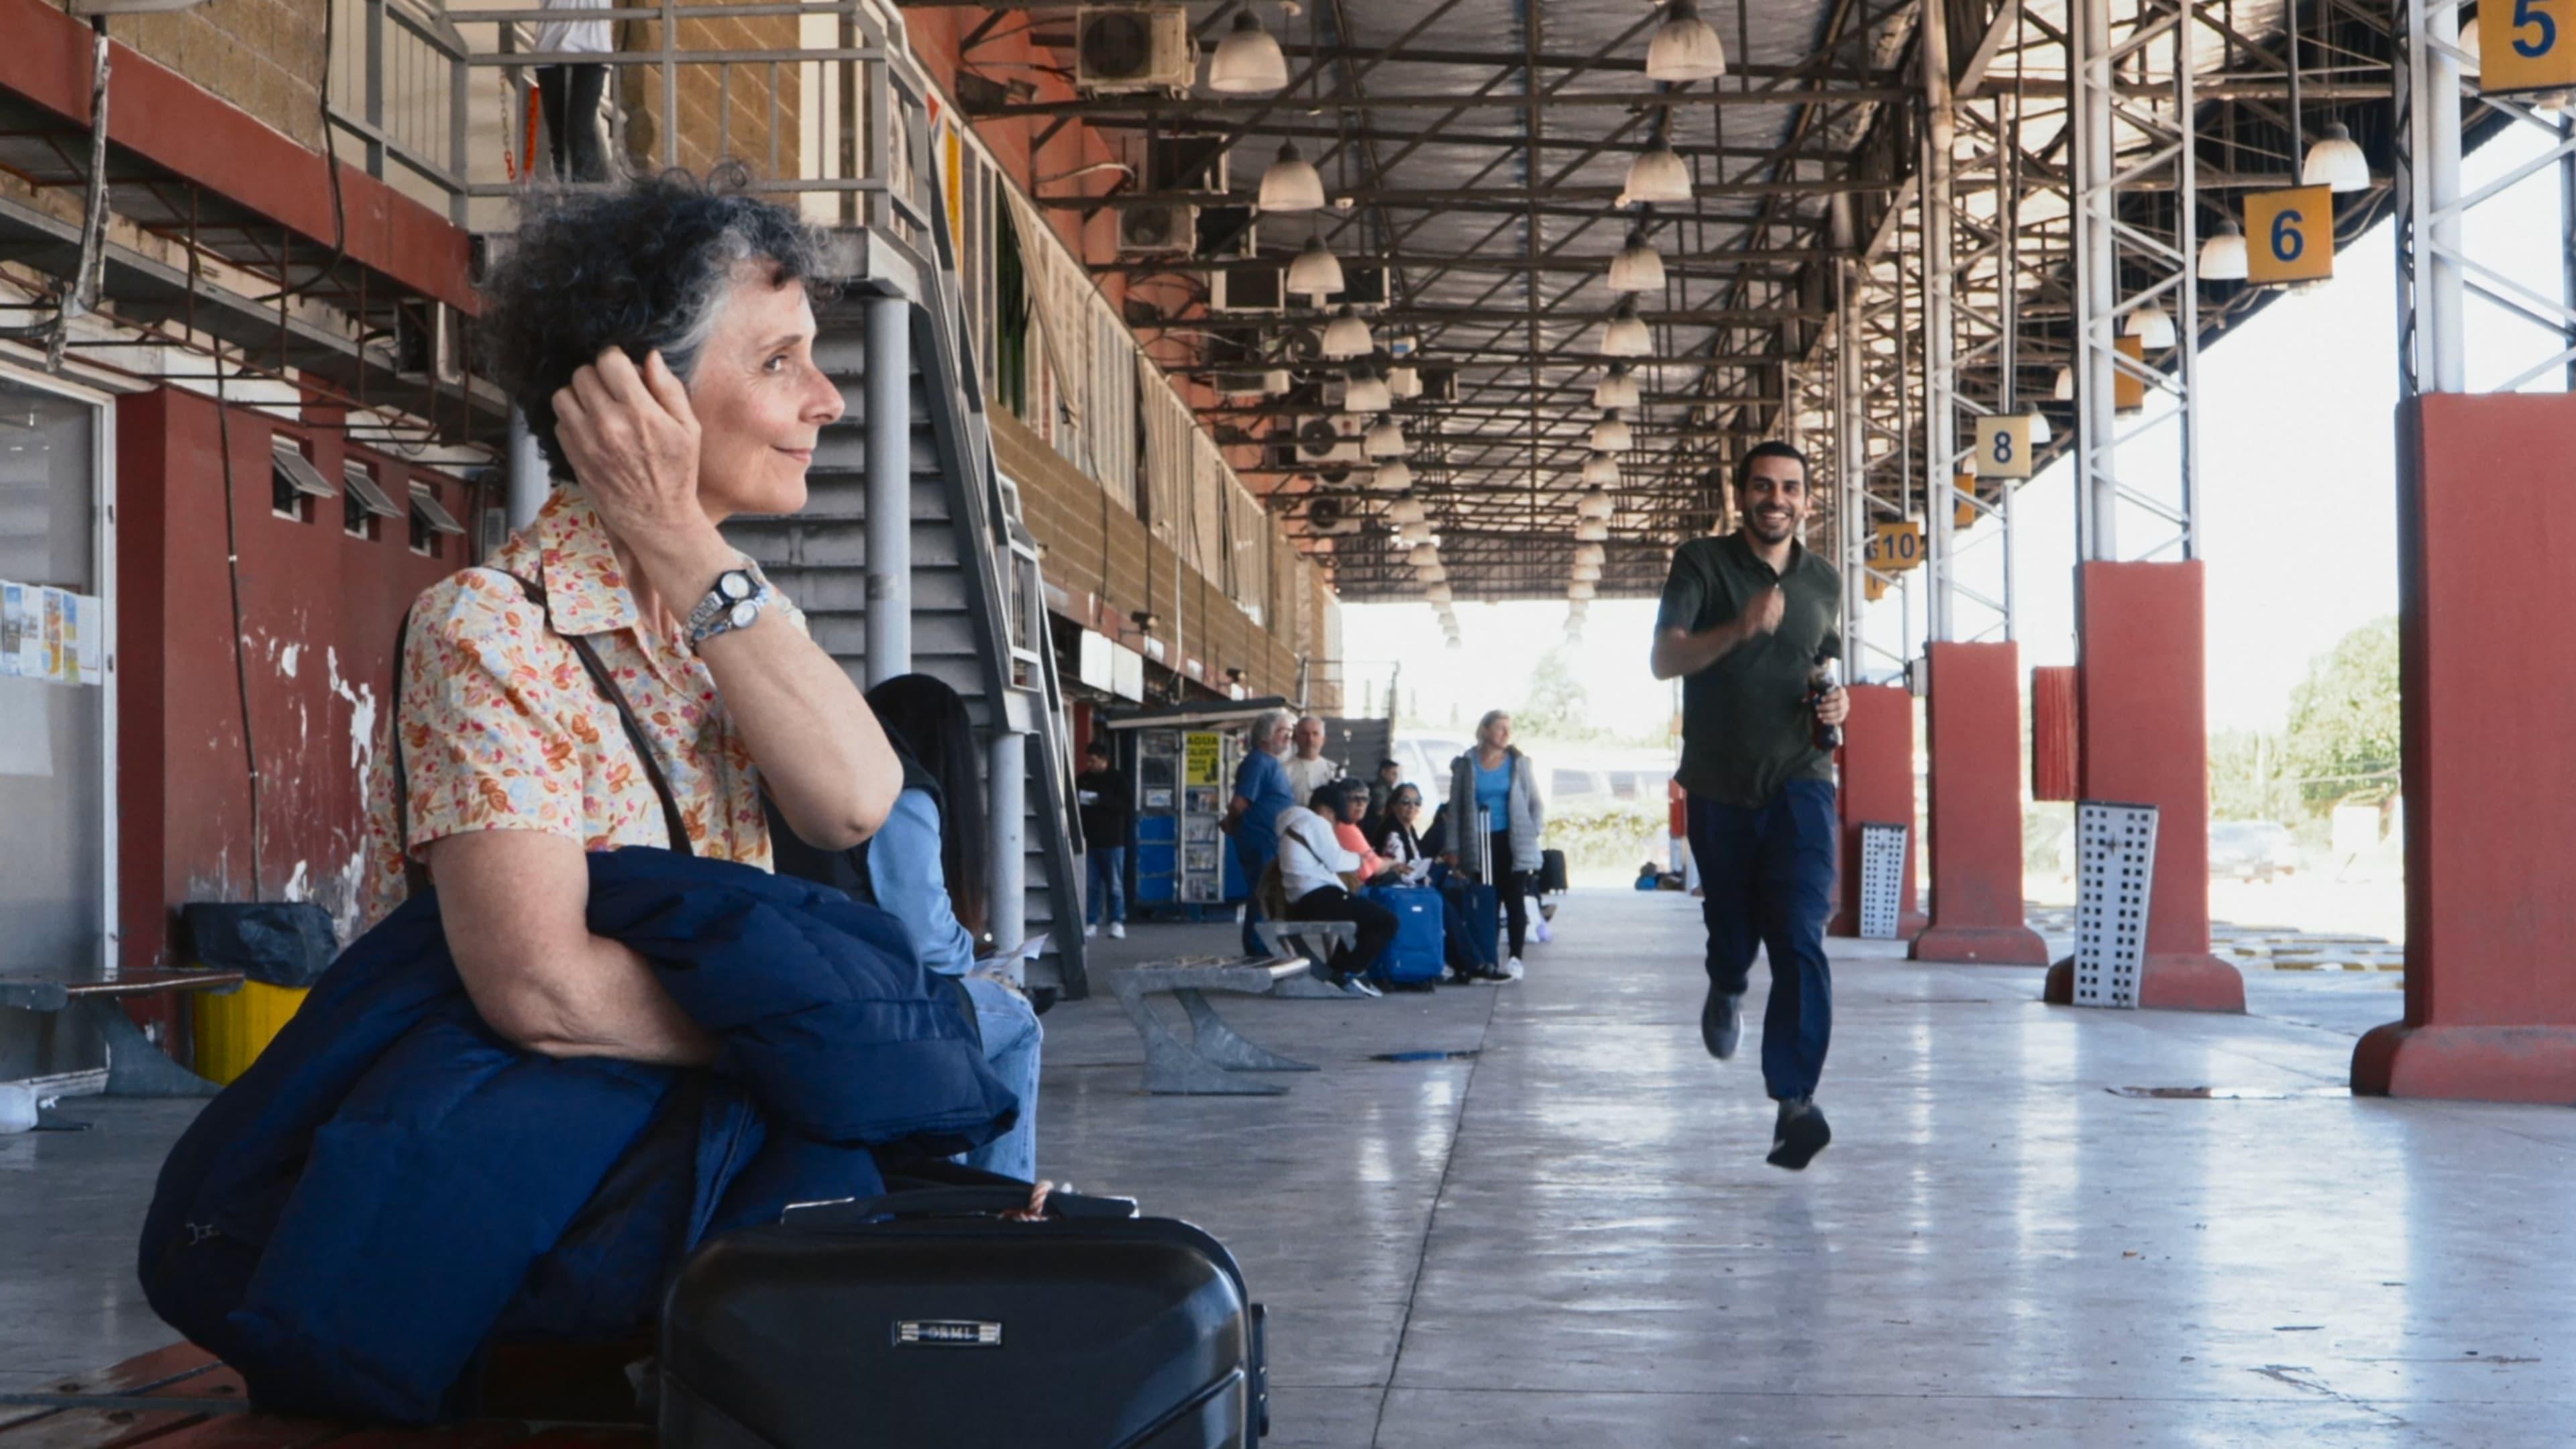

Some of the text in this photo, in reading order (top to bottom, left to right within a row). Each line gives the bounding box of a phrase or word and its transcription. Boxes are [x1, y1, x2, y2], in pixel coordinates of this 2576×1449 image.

[2512, 0, 2556, 58] 5
[2271, 209, 2303, 262] 6
[1994, 431, 2012, 464] 8
[1884, 533, 1915, 559] 10
[1187, 736, 1218, 745] AGUA
